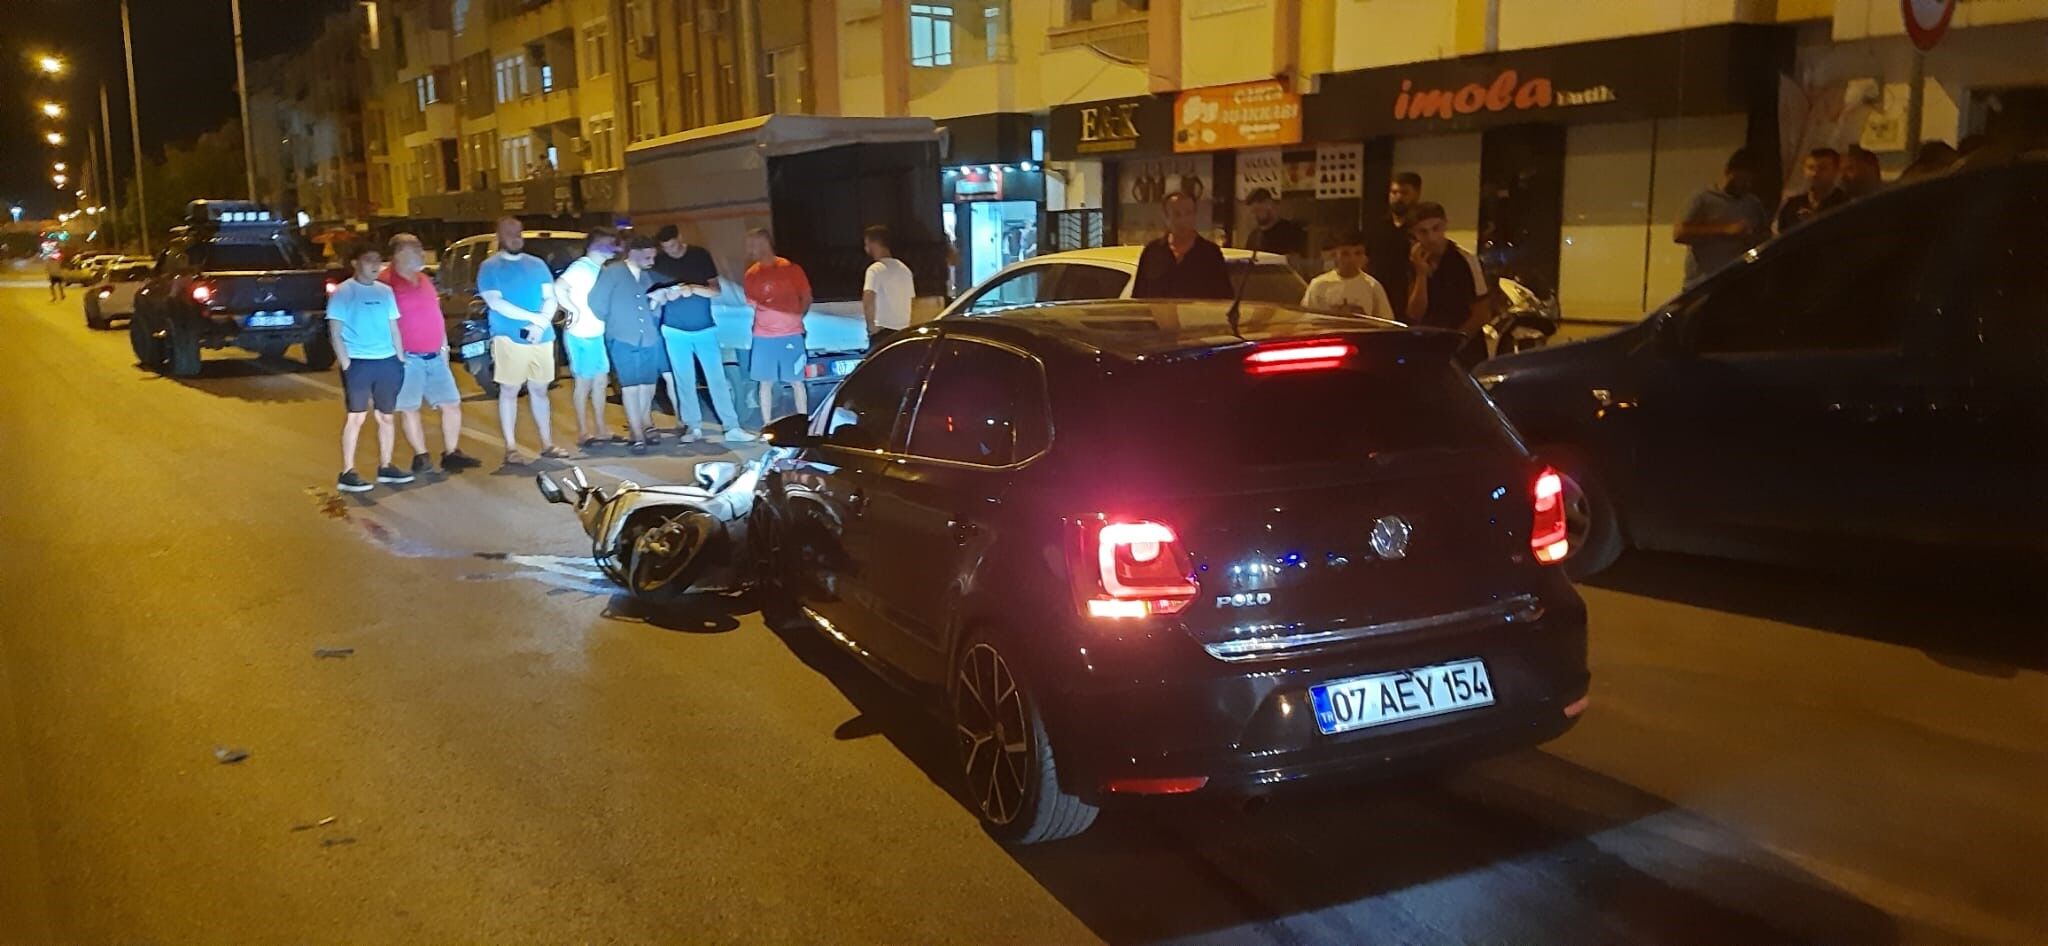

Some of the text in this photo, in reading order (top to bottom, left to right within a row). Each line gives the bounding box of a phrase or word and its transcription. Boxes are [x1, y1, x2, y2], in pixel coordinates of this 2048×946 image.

[1394, 70, 1552, 120] imola
[1216, 592, 1271, 608] POLO
[1332, 666, 1488, 721] 07 AEY 154
